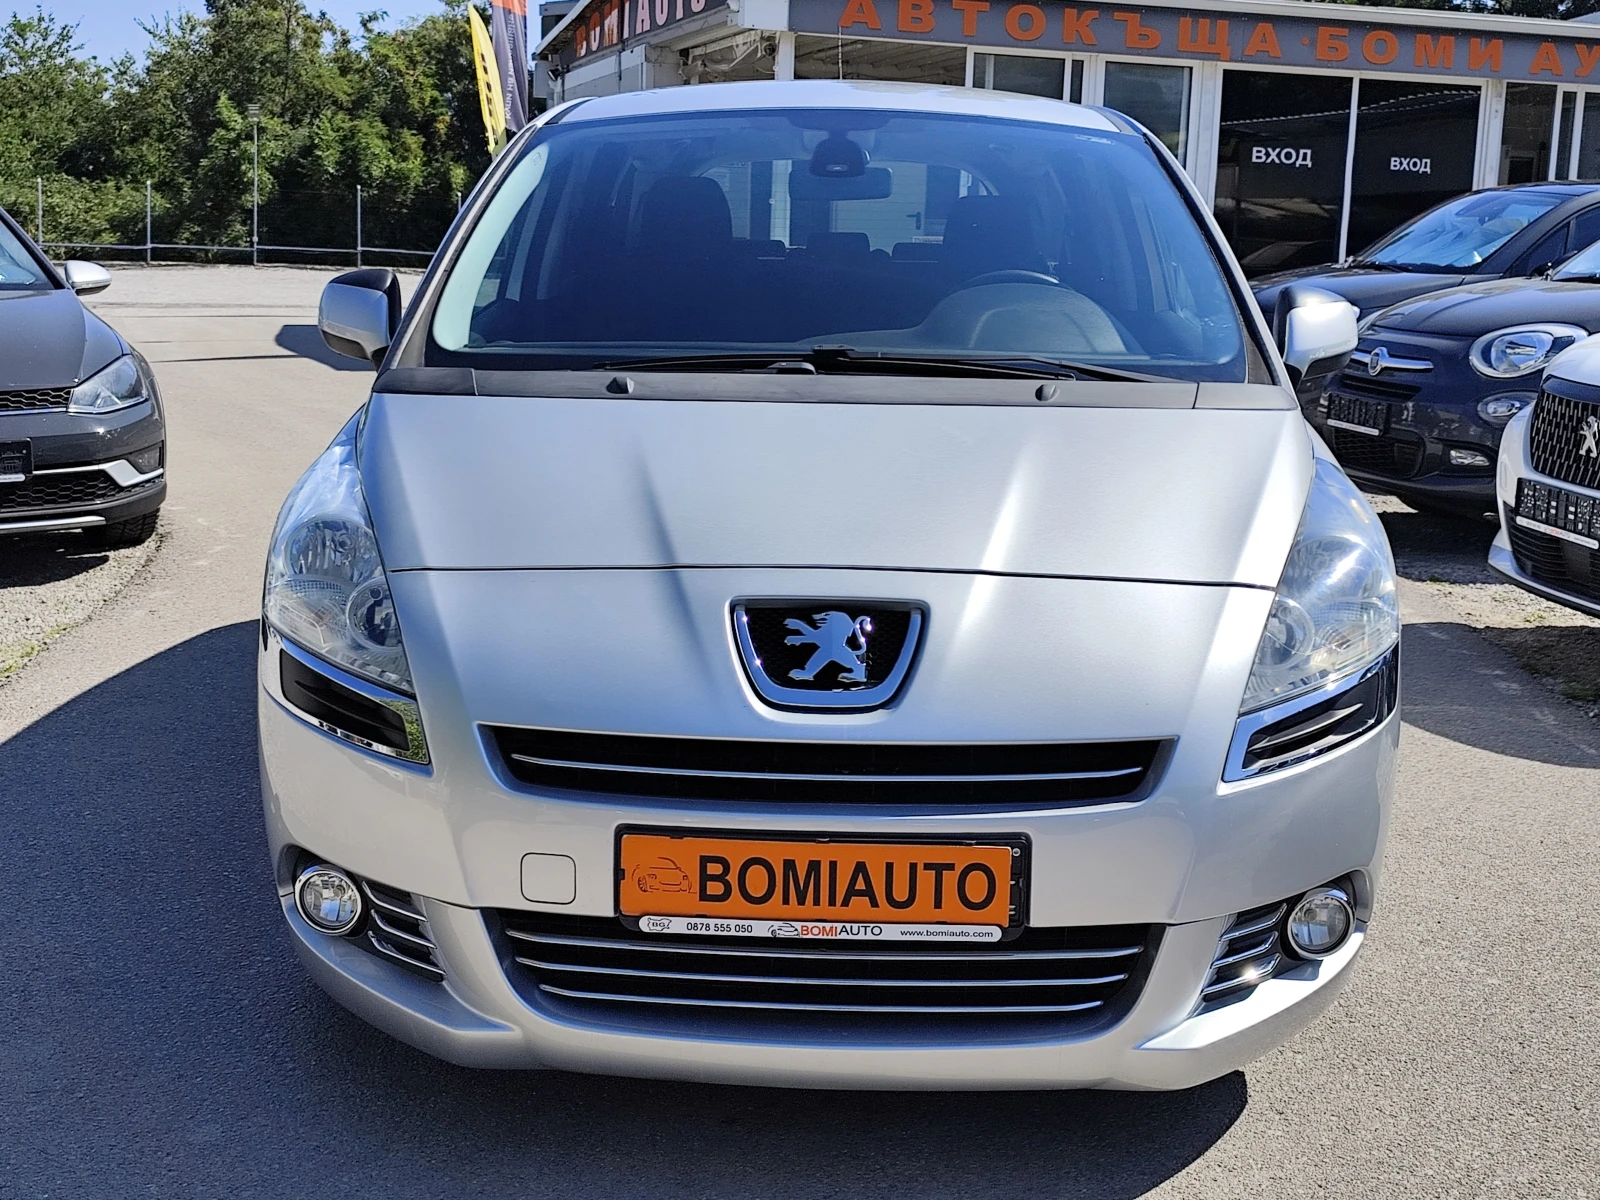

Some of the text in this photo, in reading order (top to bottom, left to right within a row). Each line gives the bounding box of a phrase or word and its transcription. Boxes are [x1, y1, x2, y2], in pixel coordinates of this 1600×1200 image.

[575, 0, 706, 58] BOMIA
[838, 0, 1600, 77] АВТОКЪЩА БОМИ АУ
[1251, 146, 1312, 168] ВХОД
[1390, 157, 1431, 174] ВХОД
[699, 855, 997, 911] BOMIAUTO
[686, 922, 711, 932] 0878
[713, 924, 732, 933] 555
[734, 924, 753, 934] 050
[801, 924, 883, 937] BOMIAUTO
[900, 929, 994, 938] www.bomiauto.com
